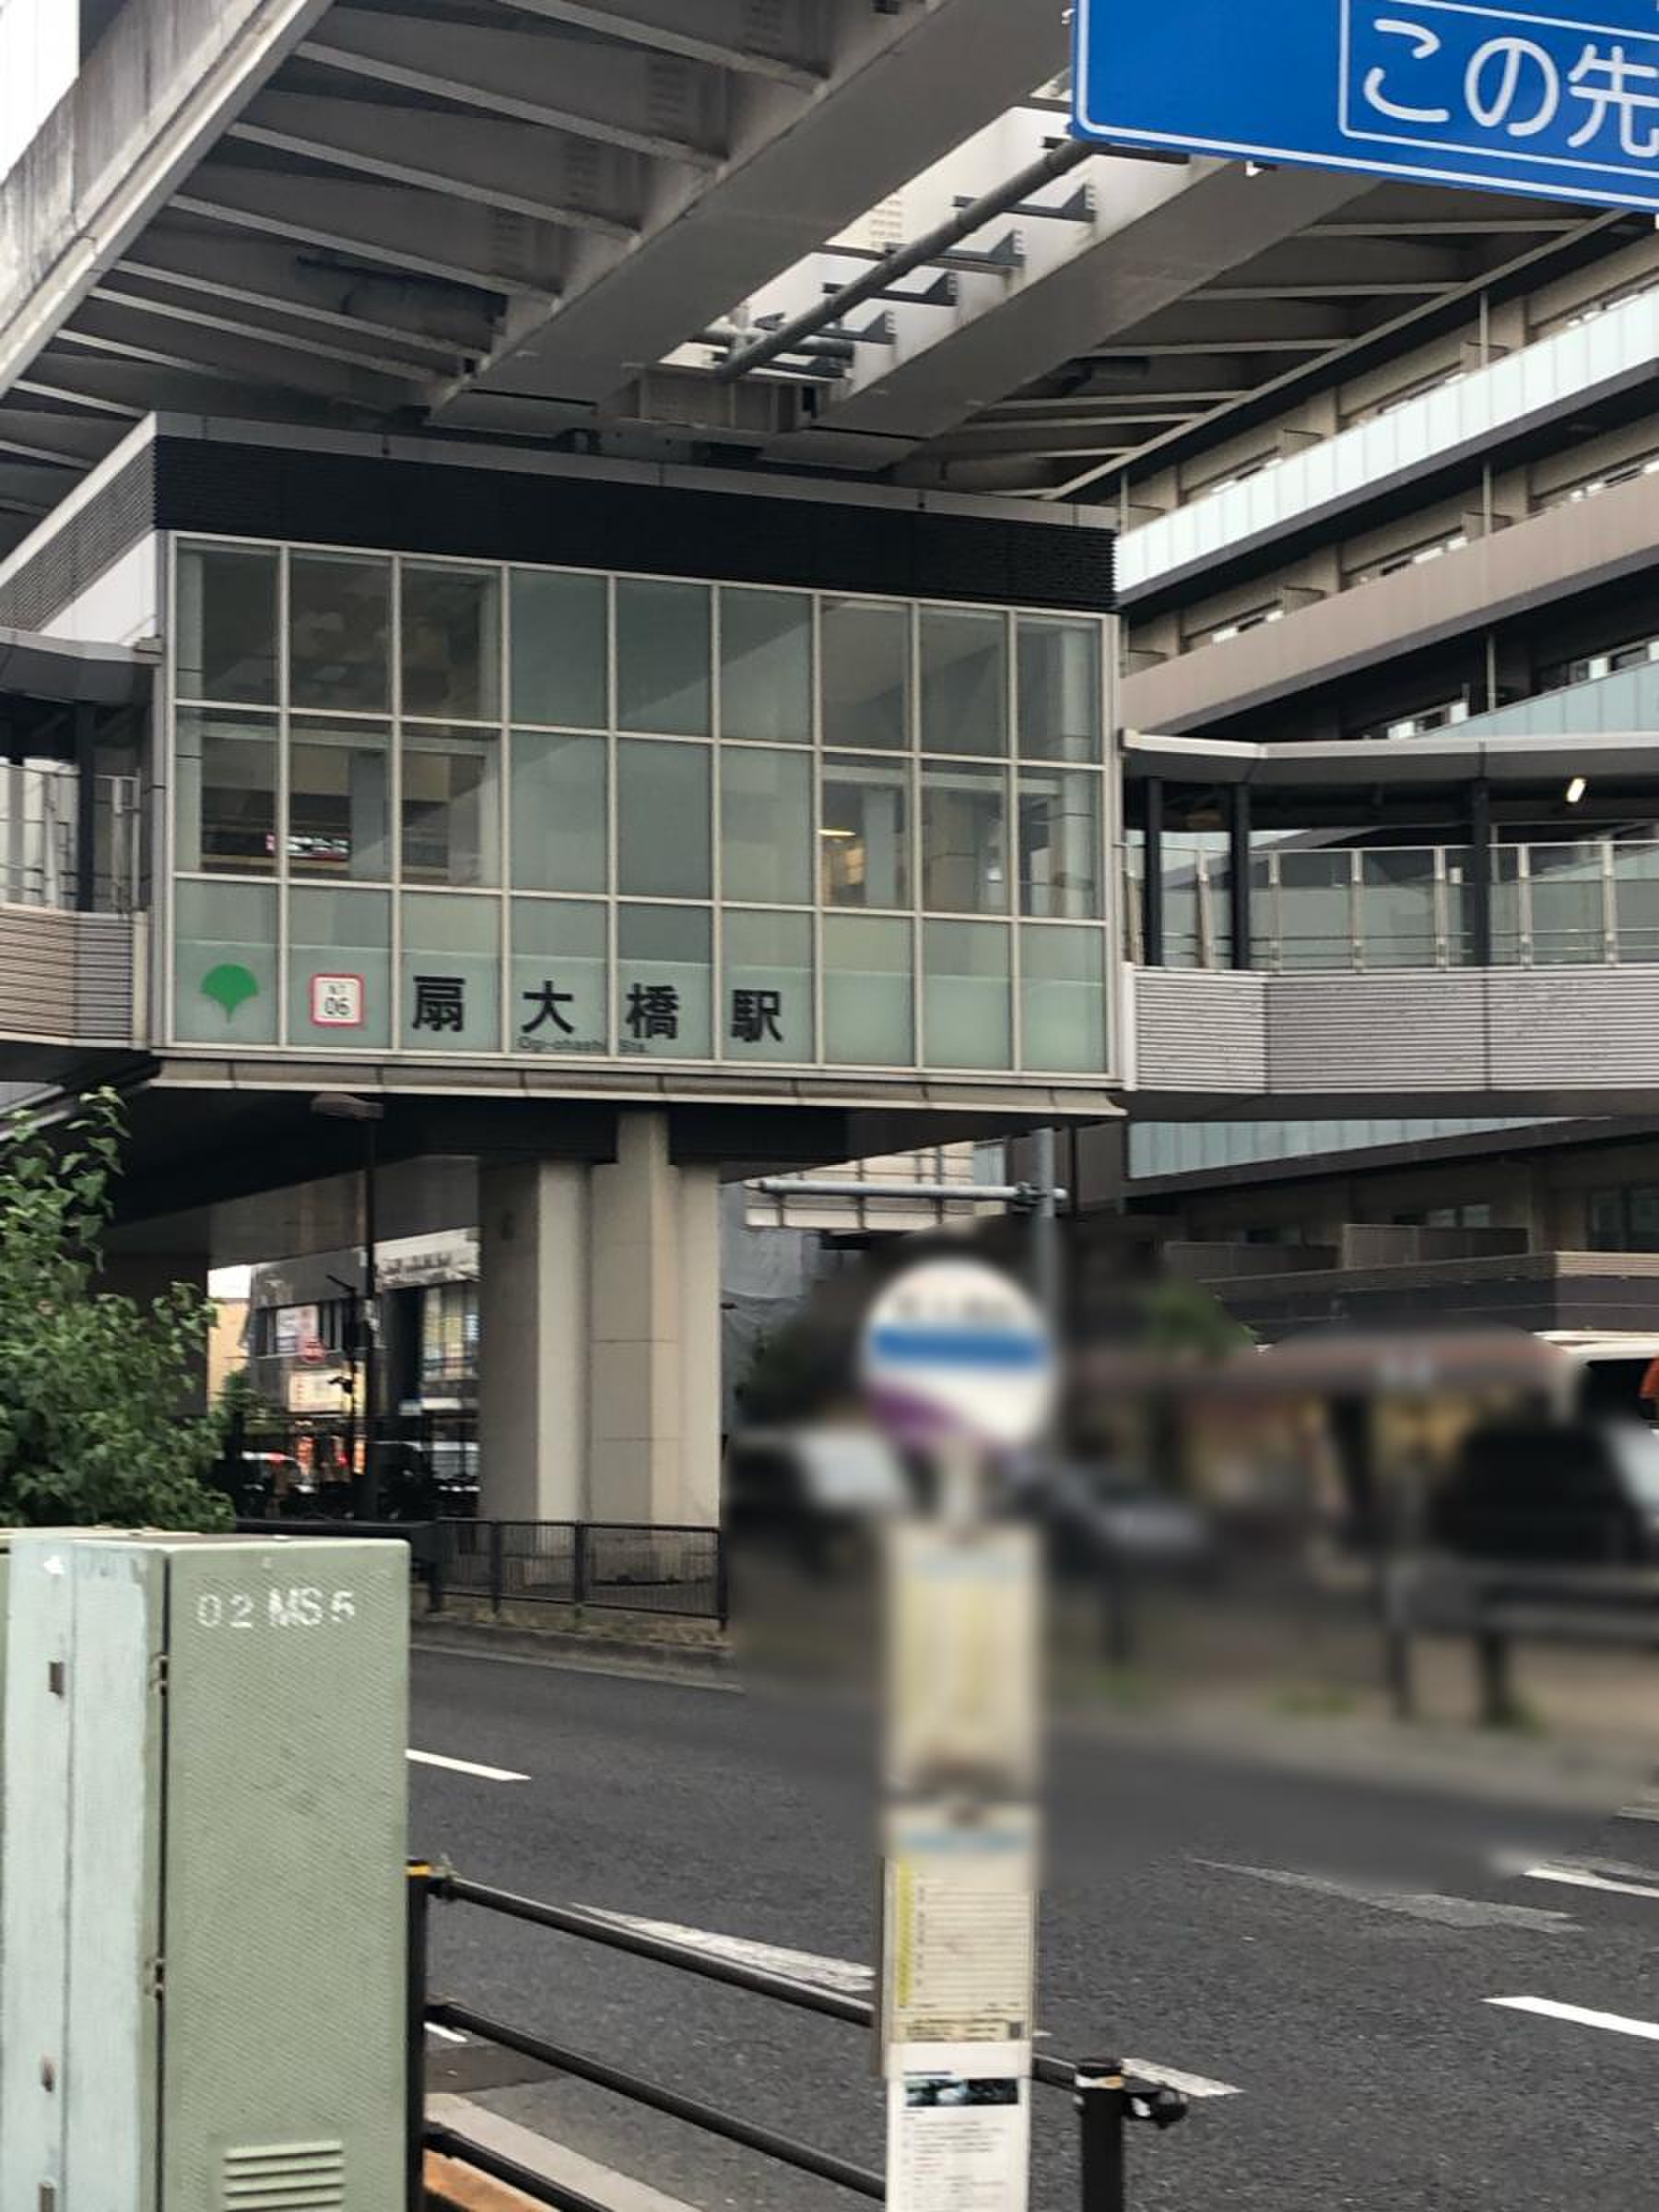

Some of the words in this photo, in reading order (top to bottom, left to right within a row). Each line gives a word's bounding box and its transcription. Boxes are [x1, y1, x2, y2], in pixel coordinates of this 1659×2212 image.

[1363, 18, 1659, 158] この先
[324, 996, 350, 1017] 06
[412, 975, 783, 1042] 扇大橋駅
